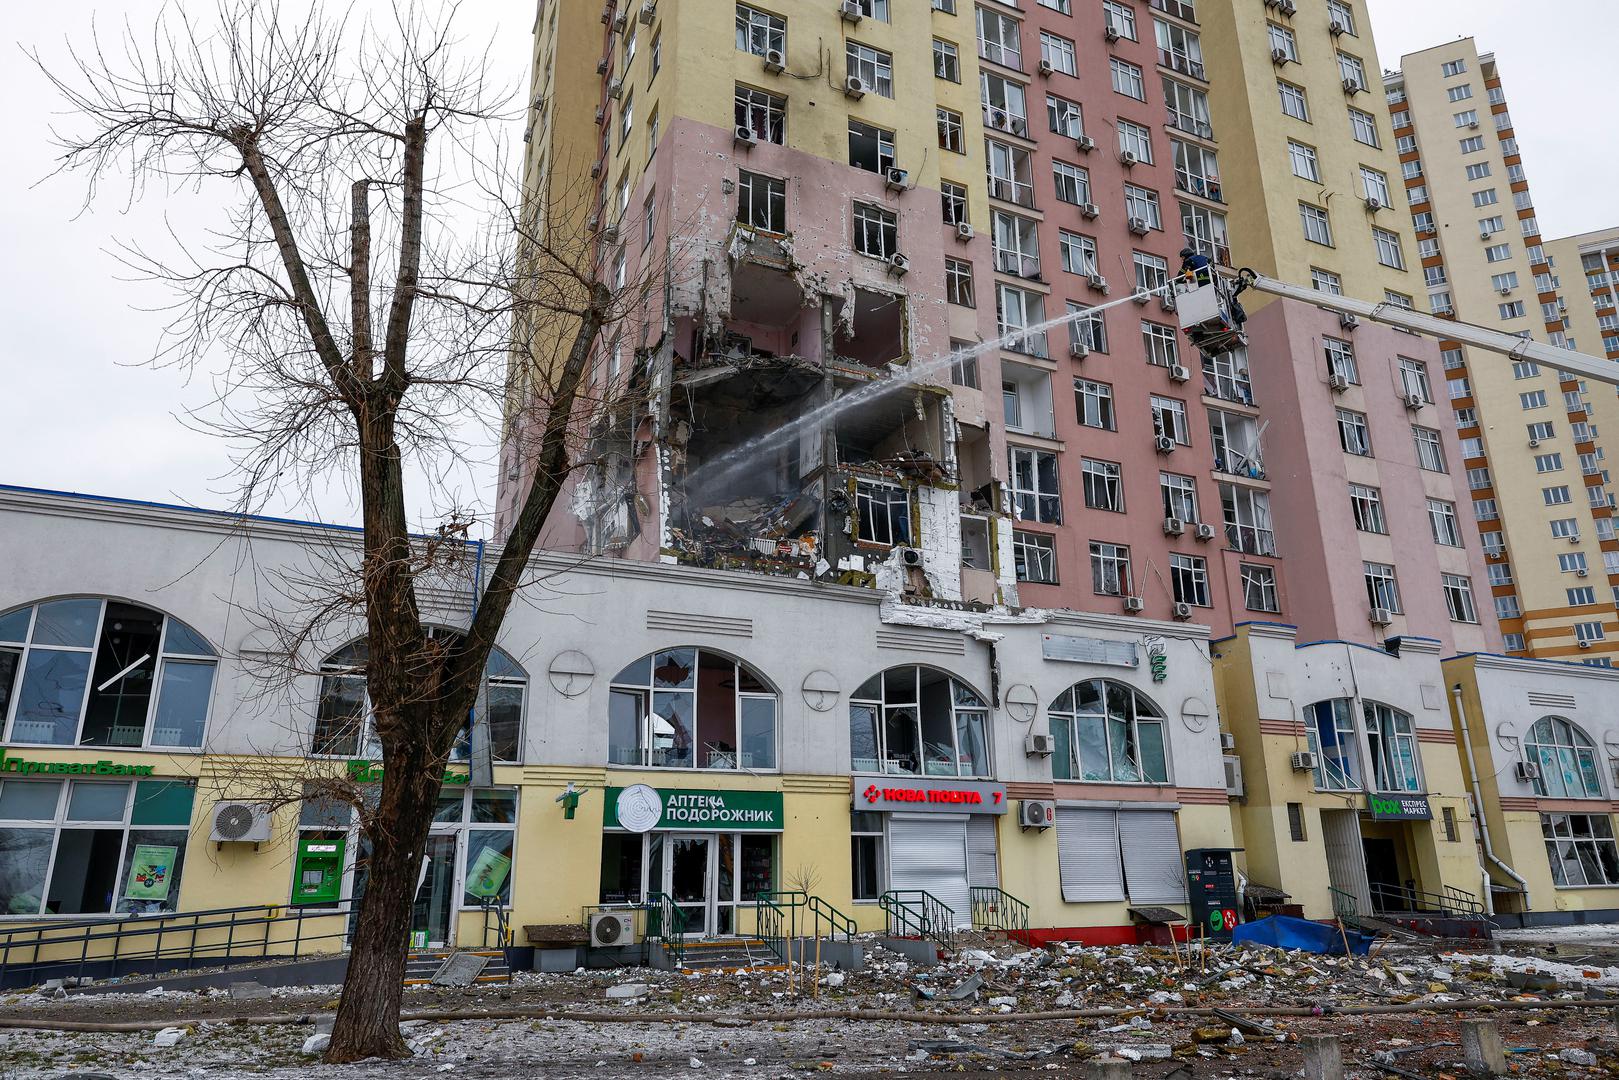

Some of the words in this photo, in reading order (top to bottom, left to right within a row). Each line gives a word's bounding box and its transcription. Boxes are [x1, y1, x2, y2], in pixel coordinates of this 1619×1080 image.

[4, 757, 155, 776] ПриватБанк
[667, 795, 725, 808] АПТЕКА
[883, 788, 926, 802] НОВА
[928, 790, 982, 804] ПОШТА
[993, 792, 1003, 804] 7
[1401, 800, 1427, 808] ЕКСПРЕС
[666, 808, 774, 822] ПОДОРОЖНИК
[1403, 807, 1427, 815] МАРКЕТ
